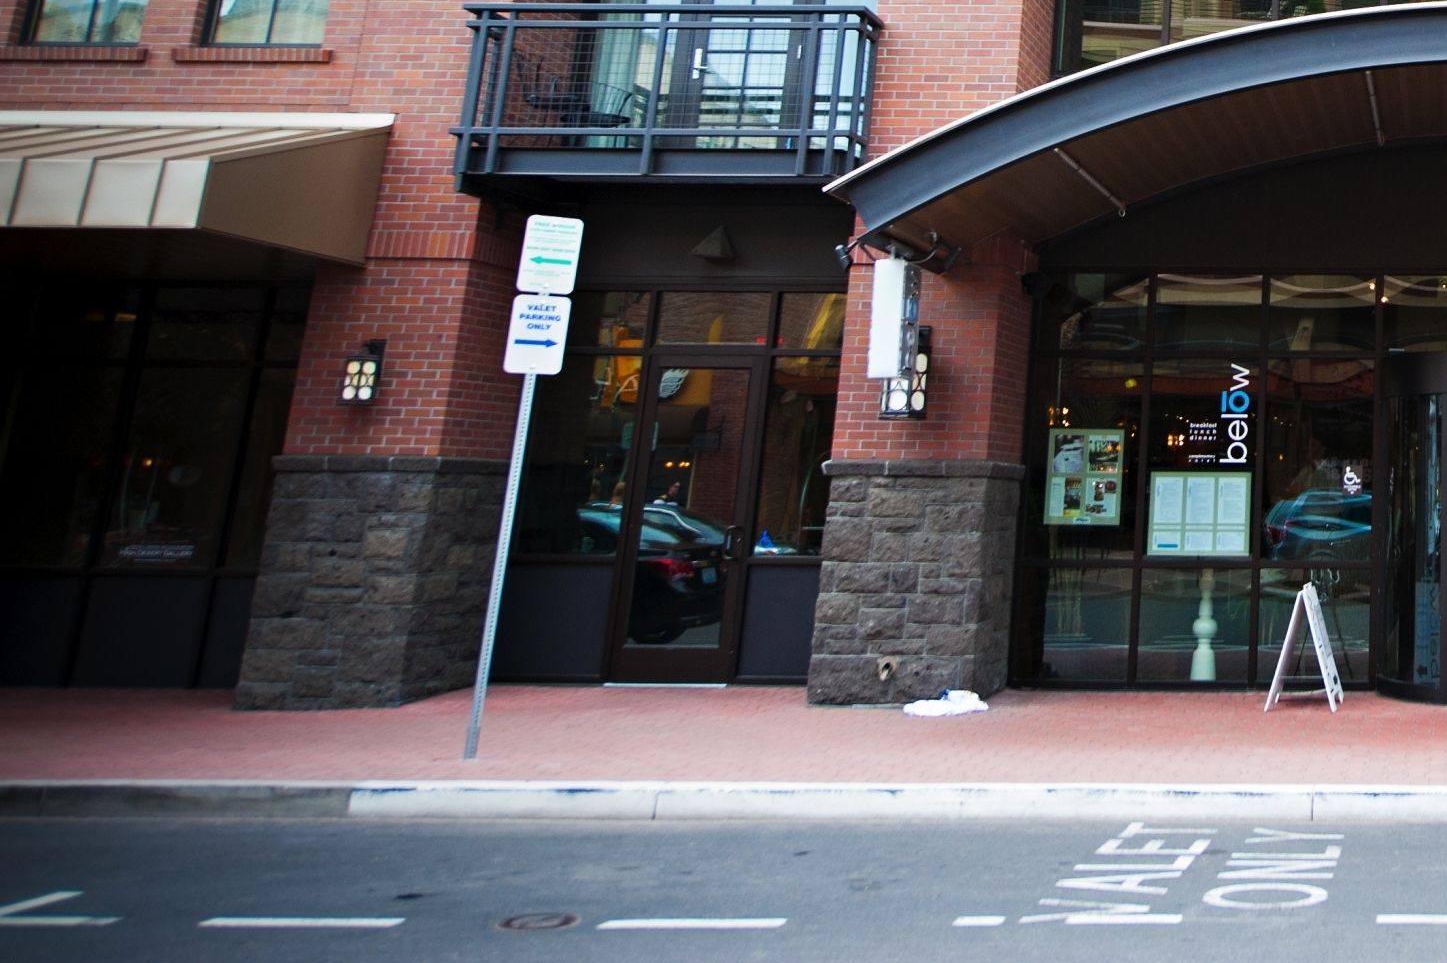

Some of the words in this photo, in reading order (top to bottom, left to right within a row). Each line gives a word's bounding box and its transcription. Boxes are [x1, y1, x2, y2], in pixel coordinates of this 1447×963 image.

[527, 304, 557, 312] VALET
[519, 313, 561, 322] PARKING
[527, 322, 551, 330] ONLY
[1019, 821, 1218, 924] VALET
[1202, 827, 1345, 910] ONLY
